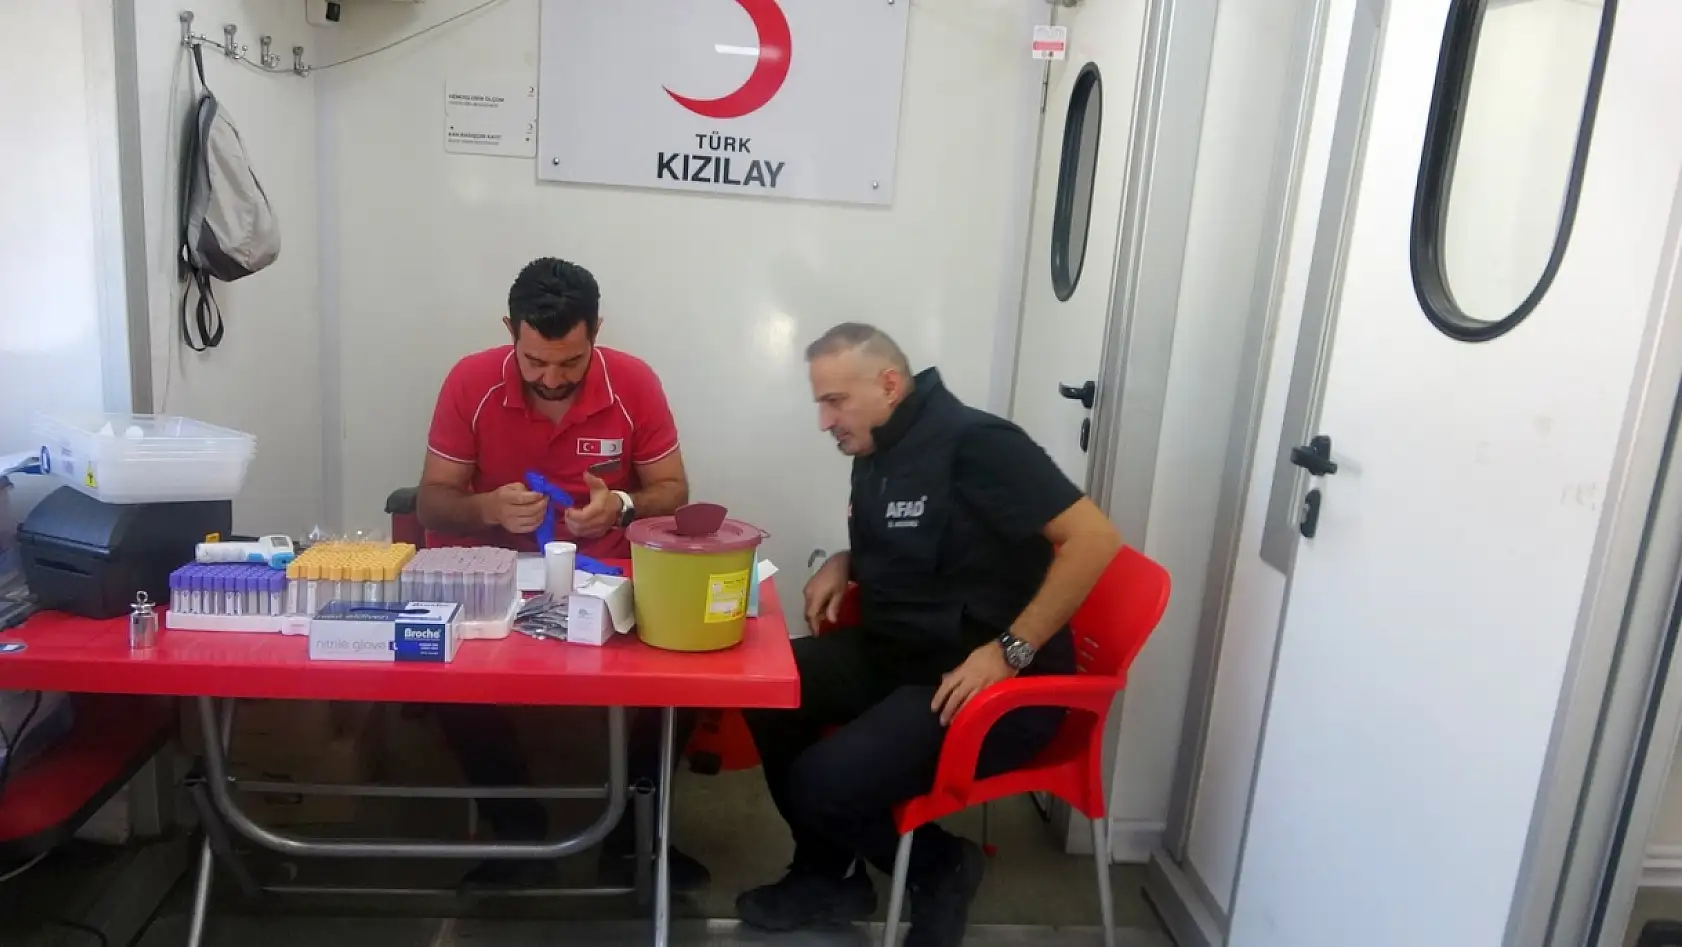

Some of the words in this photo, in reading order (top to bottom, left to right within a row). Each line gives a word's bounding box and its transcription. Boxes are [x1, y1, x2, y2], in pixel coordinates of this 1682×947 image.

[695, 130, 751, 153] TÜRK
[657, 151, 785, 188] KIZILAY
[885, 500, 925, 518] AFAD
[316, 637, 348, 649] nitrile
[352, 639, 386, 653] glove
